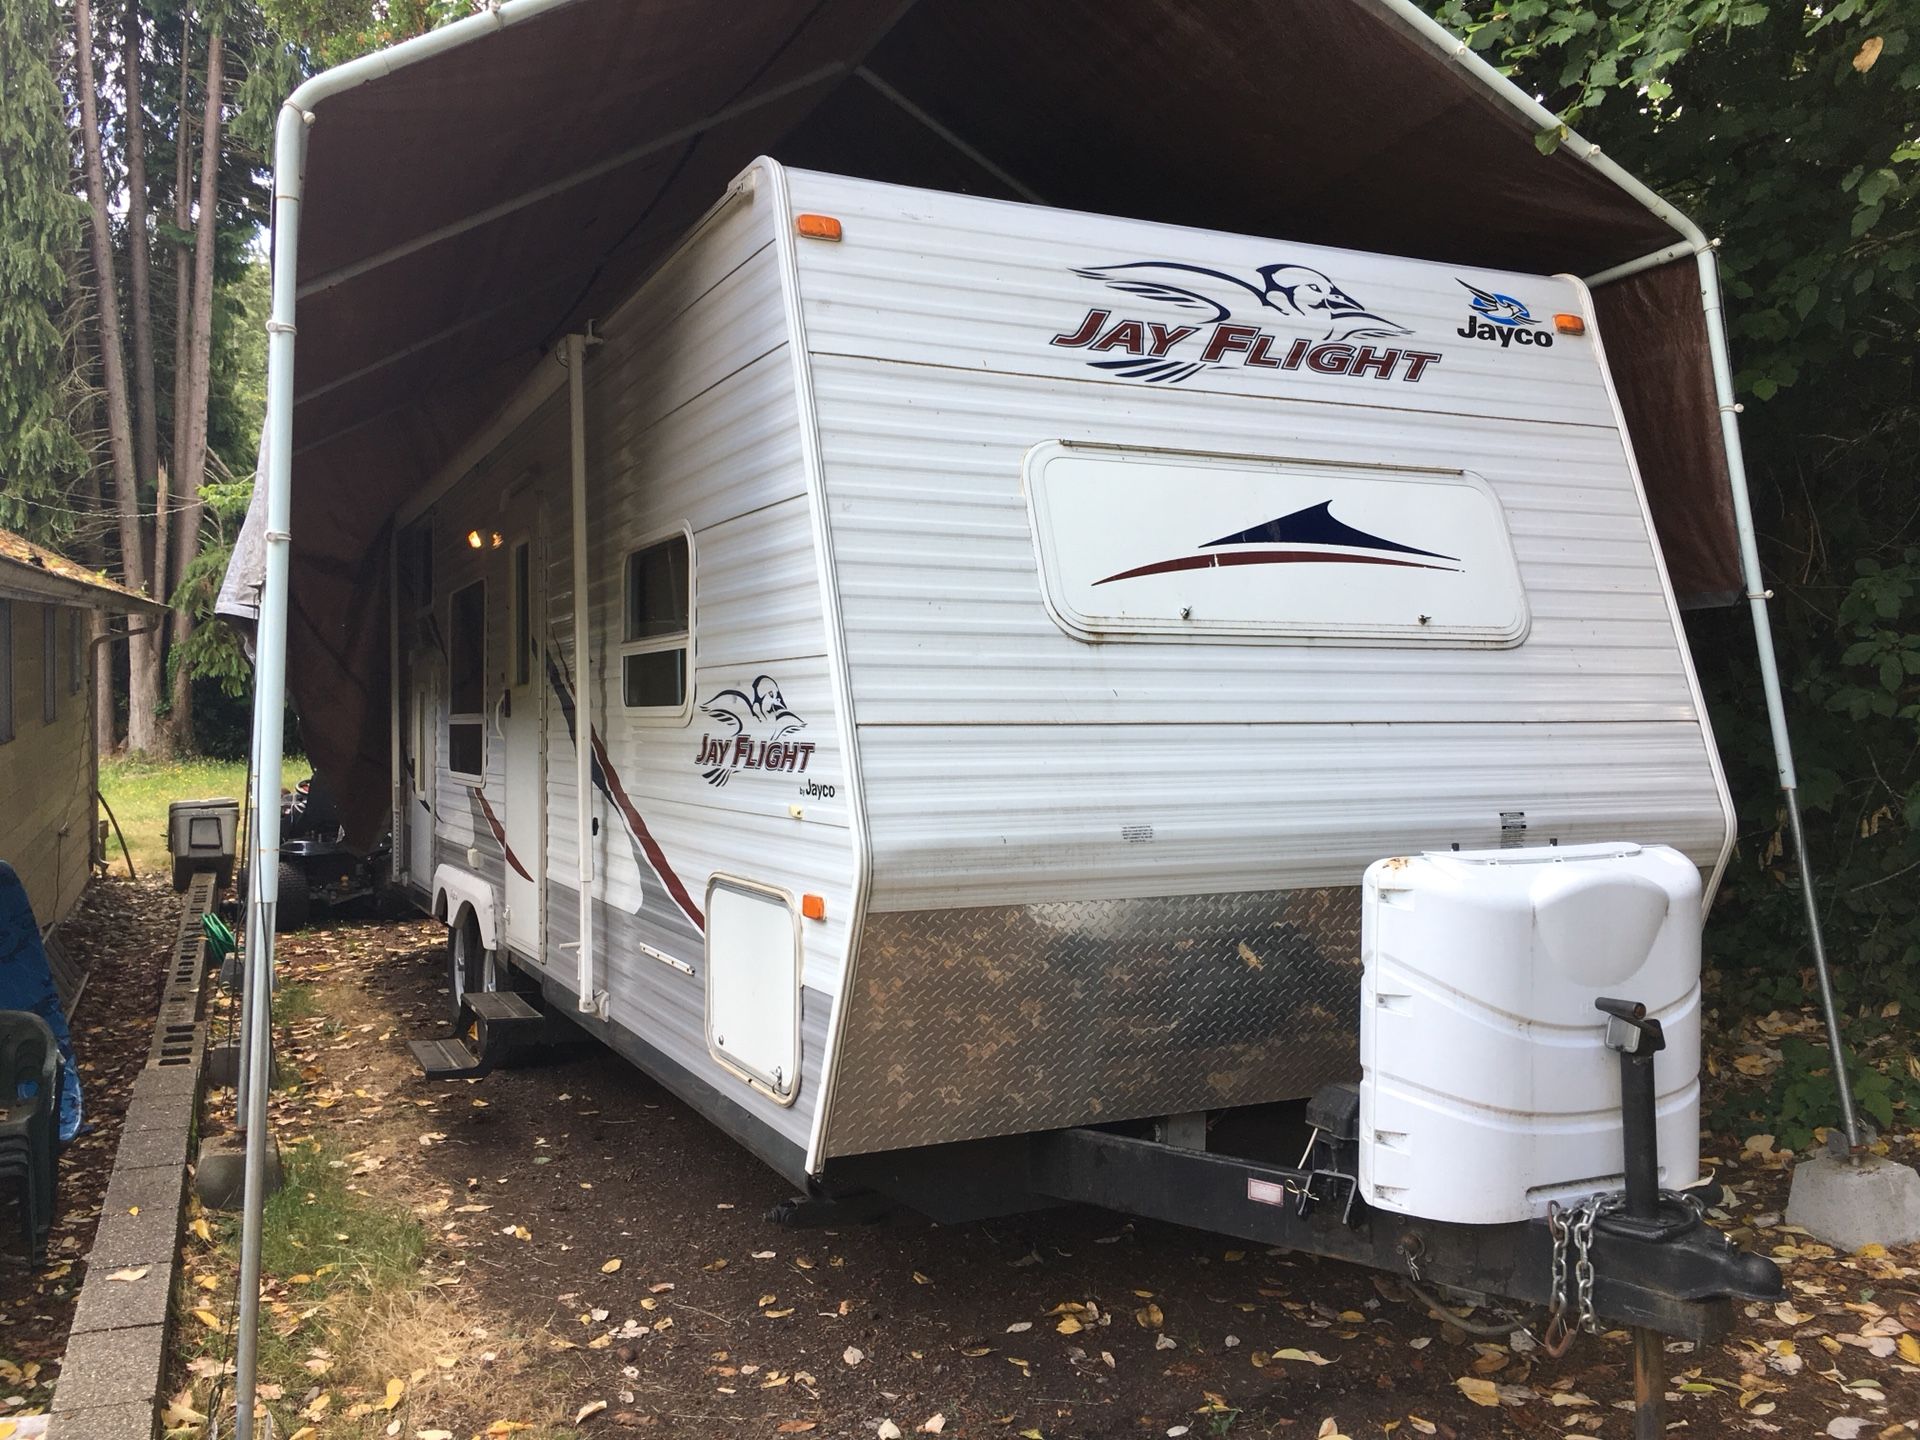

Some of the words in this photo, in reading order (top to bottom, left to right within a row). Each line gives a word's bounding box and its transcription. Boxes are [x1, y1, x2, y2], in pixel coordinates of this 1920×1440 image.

[1049, 308, 1202, 358] JAY
[1200, 323, 1443, 382] FLIGHT
[1457, 315, 1554, 348] Jayco
[695, 733, 733, 766] JAY
[731, 734, 816, 773] FLIGHT
[799, 786, 805, 797] by
[806, 778, 836, 801] Jayco
